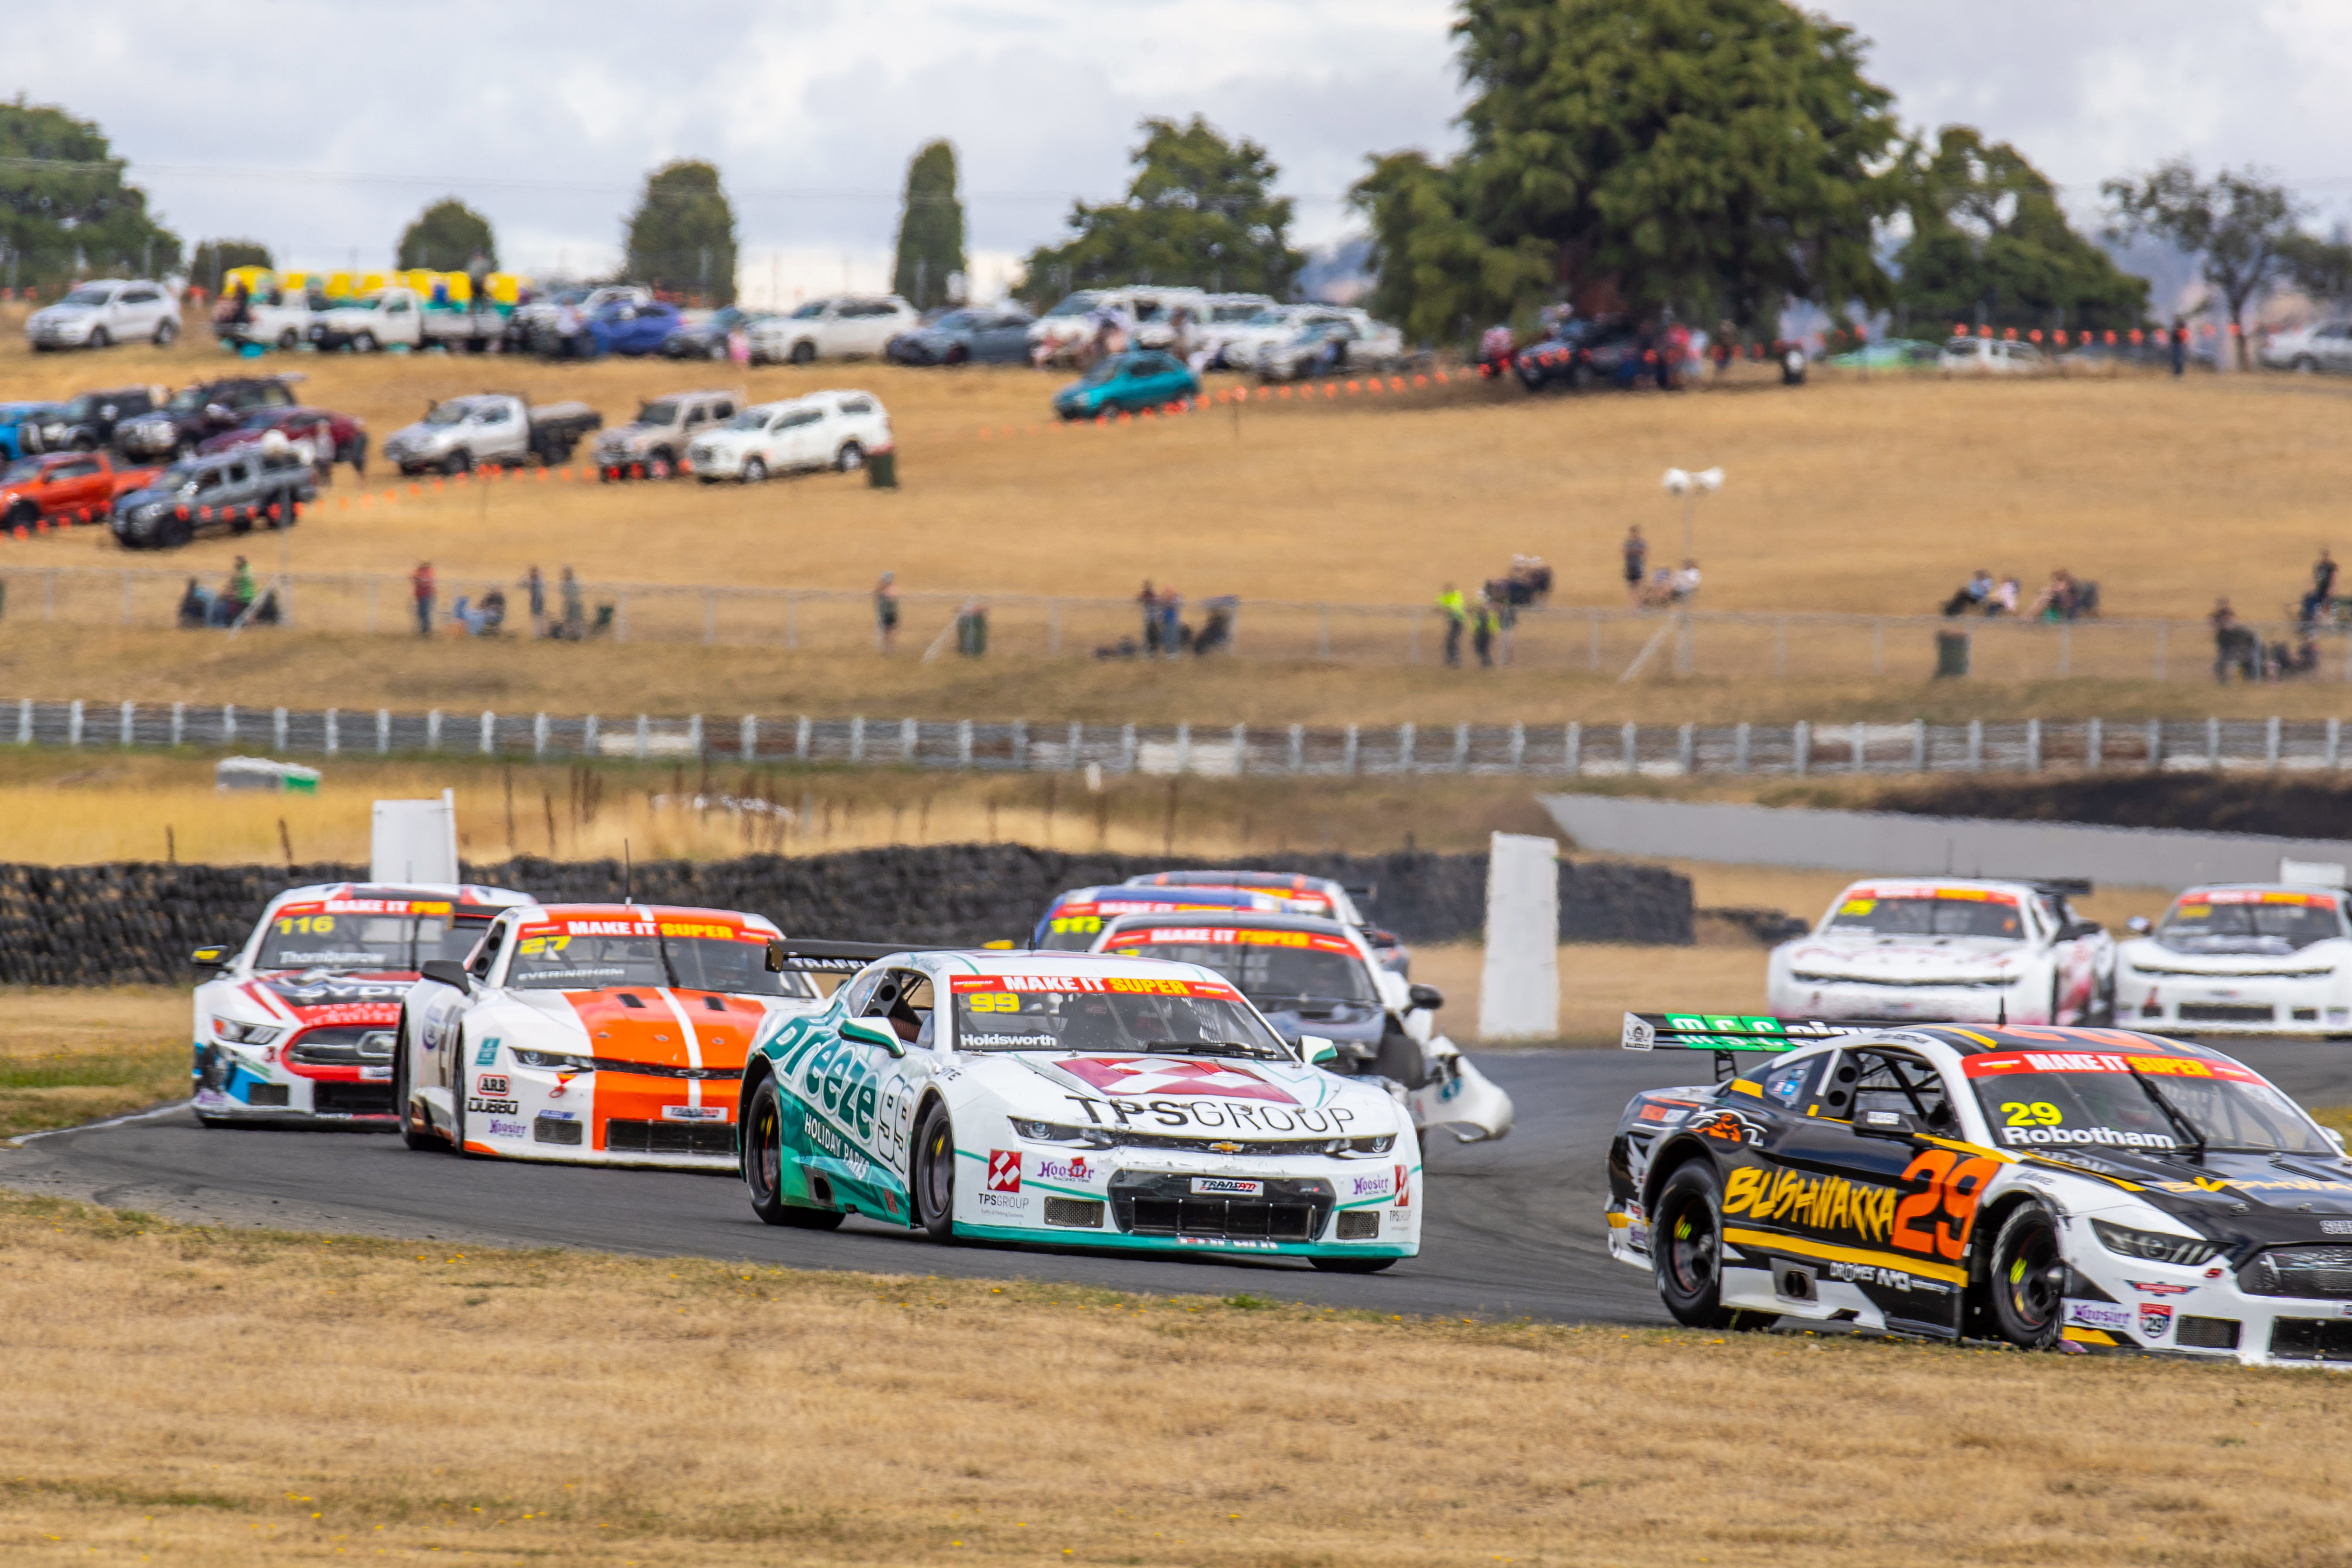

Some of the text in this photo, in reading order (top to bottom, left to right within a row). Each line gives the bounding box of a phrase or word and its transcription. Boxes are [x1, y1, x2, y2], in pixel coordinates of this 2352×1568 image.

[324, 900, 384, 913] MAKE
[387, 900, 409, 913] IT
[276, 916, 335, 934] 116
[568, 921, 631, 935] MAKE
[635, 922, 656, 935] IT
[660, 923, 734, 939] SUPER
[519, 936, 572, 954] 27
[1150, 929, 1309, 947] MAKE IT SUPER
[788, 958, 875, 970] TRAFFI
[1002, 976, 1190, 995] MAKE IT SUPER
[969, 993, 1020, 1013] 99
[960, 1033, 1057, 1047] Holdsworth
[2023, 1054, 2105, 1070] MAKE
[2101, 1055, 2131, 1071] IT
[2127, 1056, 2213, 1076] SUPER
[481, 1078, 507, 1092] ARB
[1065, 1095, 1355, 1133] TPSGROUP
[2000, 1102, 2063, 1126] 29
[489, 1119, 527, 1134] Hoosier
[878, 1074, 915, 1174] 99
[804, 1112, 870, 1180] HOLIDAY PARKS
[2001, 1125, 2177, 1149] Robotham
[1037, 1161, 1095, 1179] Hoosier
[1353, 1175, 1389, 1195] Hoosier
[979, 1193, 1029, 1209] TPSGROUP
[1722, 1166, 1897, 1243] BUSHWAKKA
[1891, 1149, 2000, 1260] 29
